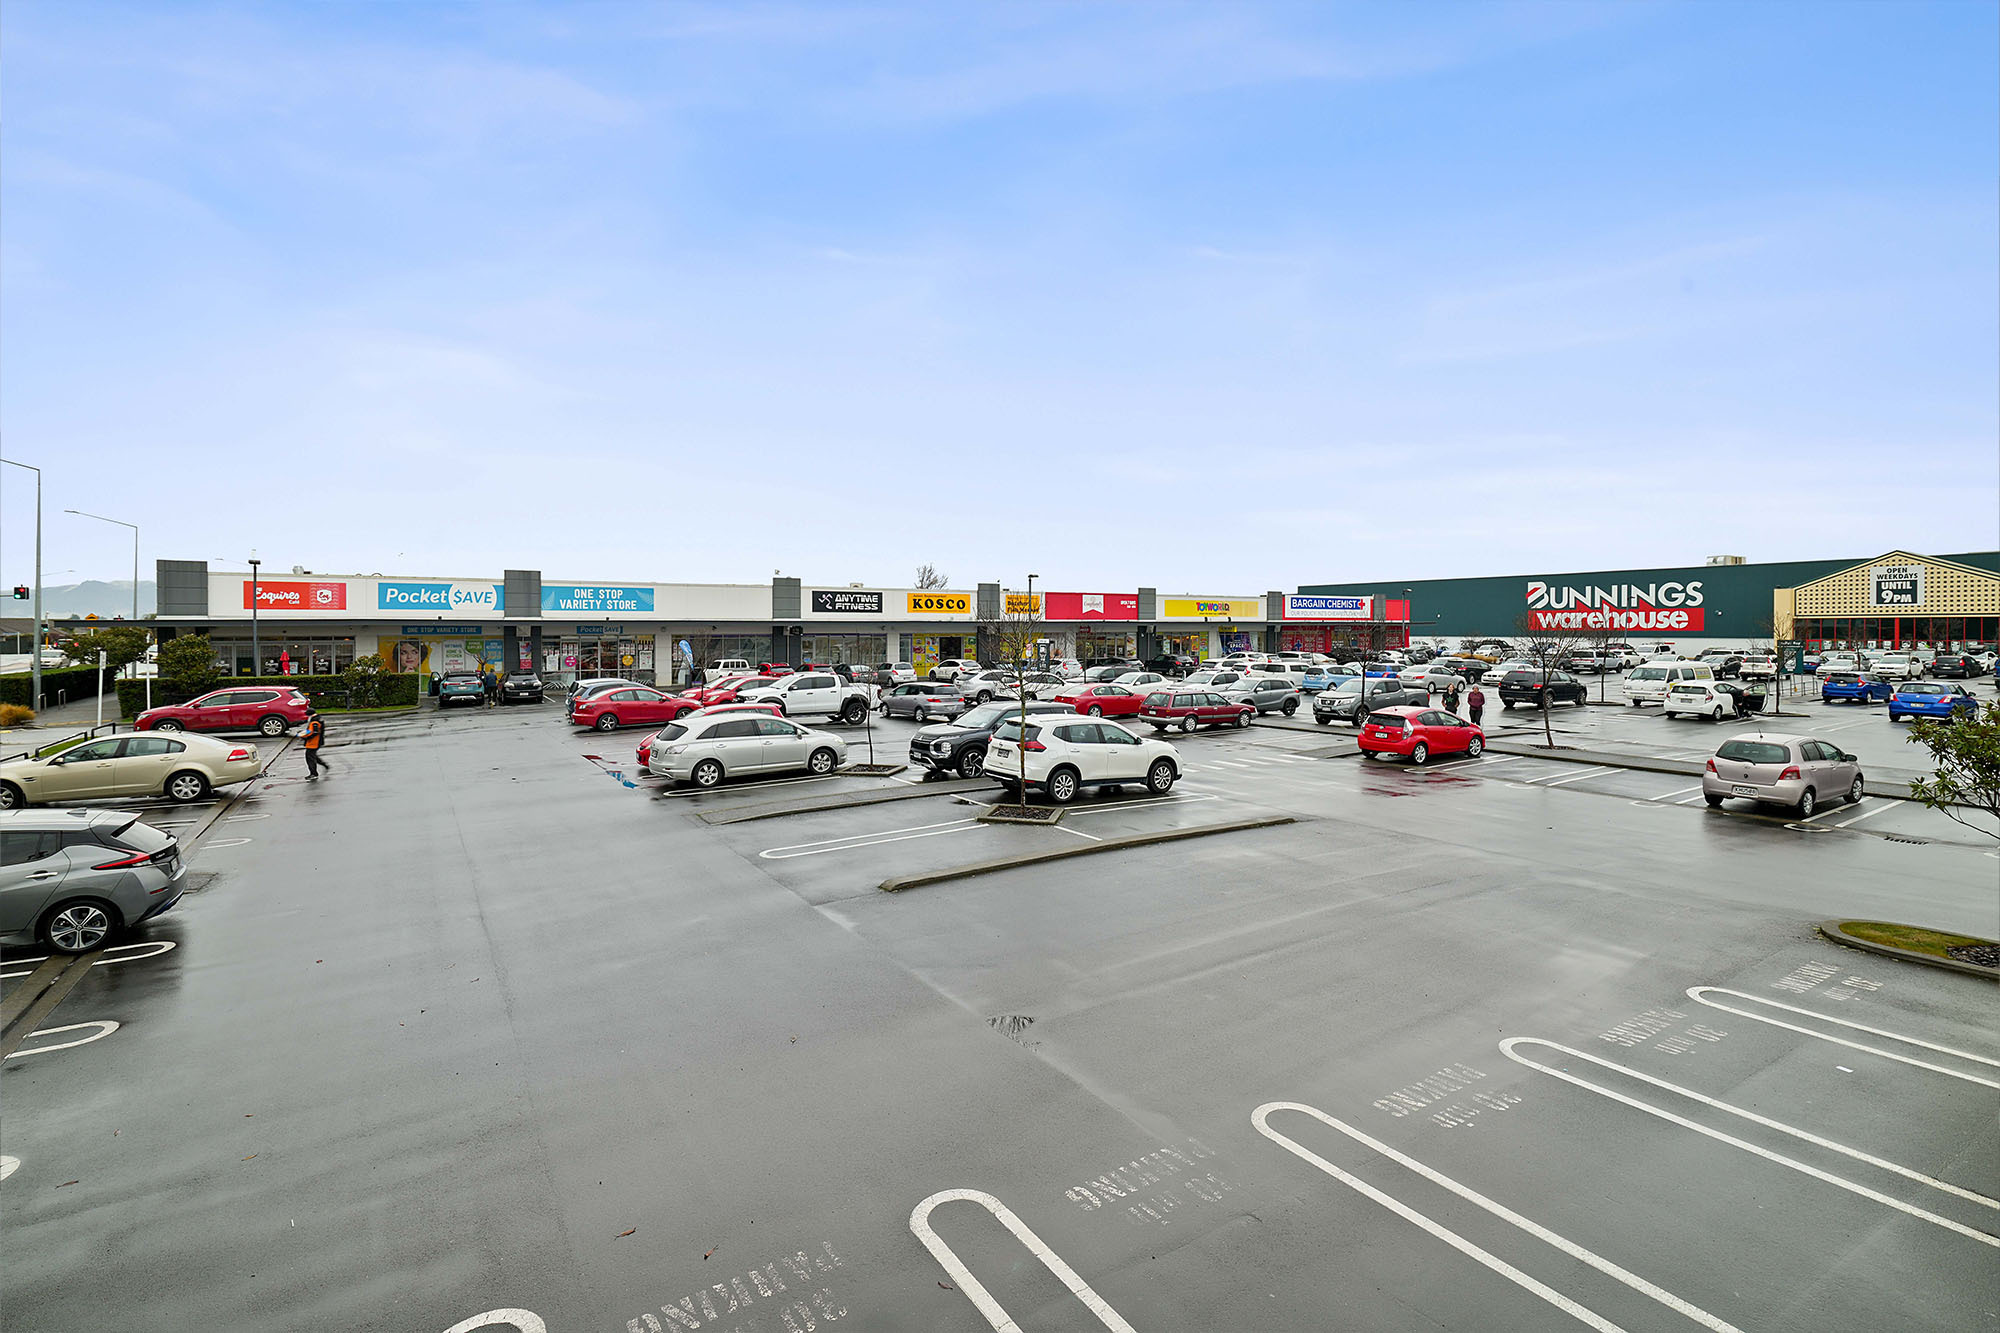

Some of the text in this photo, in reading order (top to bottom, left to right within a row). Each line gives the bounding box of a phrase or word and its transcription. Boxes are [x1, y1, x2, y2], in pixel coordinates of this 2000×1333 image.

[1881, 581, 1912, 590] UNTIL
[256, 587, 300, 605] Esquires
[385, 588, 448, 604] Pocket
[574, 588, 623, 599] ONE STOP
[834, 594, 879, 603] ANYTIME
[1526, 581, 1704, 609] BUNNINGS
[1881, 590, 1912, 603] 9PM
[559, 599, 637, 610] VARIETY STORE
[835, 602, 879, 610] FITNESS
[912, 598, 966, 610] KOSCO
[1196, 602, 1230, 611] TOYWORLD
[1292, 599, 1357, 609] BARGAIN CHEMIST
[1536, 603, 1689, 629] warehouse
